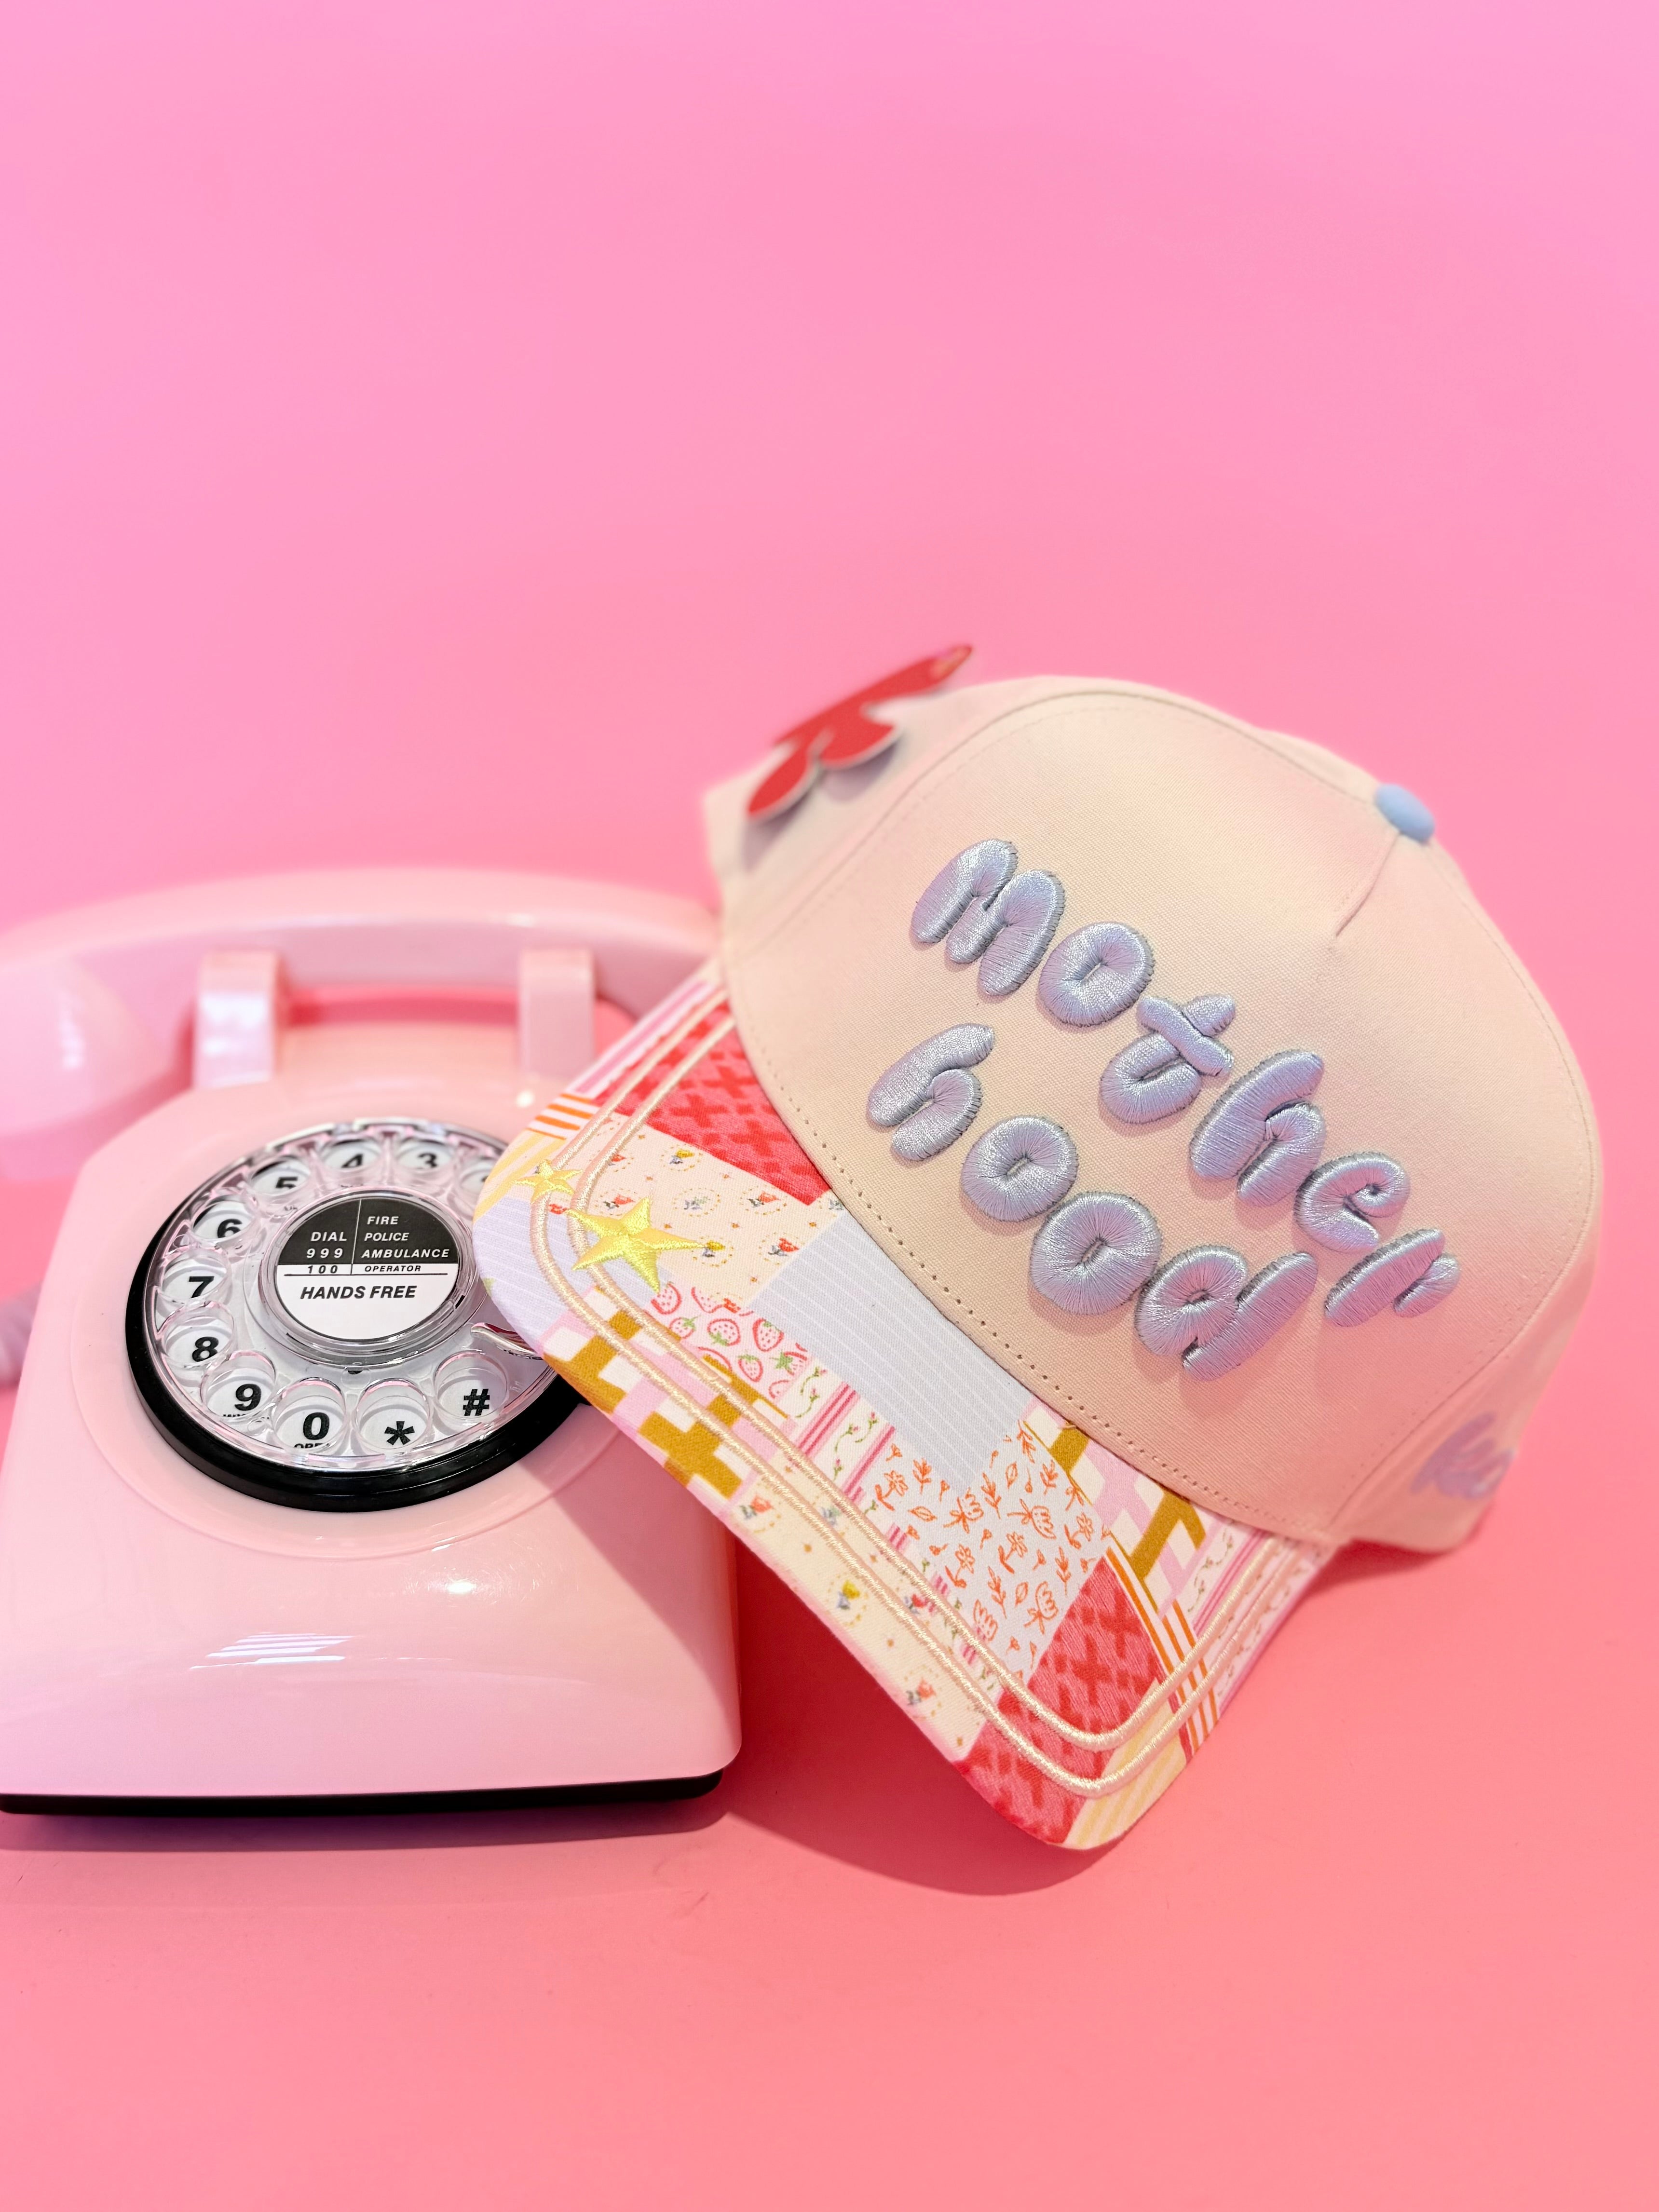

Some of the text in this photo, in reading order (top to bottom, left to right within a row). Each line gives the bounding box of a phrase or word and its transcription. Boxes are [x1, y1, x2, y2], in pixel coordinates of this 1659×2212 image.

[341, 1153, 364, 1168] 4
[419, 1153, 438, 1169] 3
[275, 1177, 298, 1189] 5
[867, 1023, 1318, 1381] hood
[367, 1216, 399, 1225] FIRE
[217, 1219, 243, 1239] 6
[311, 1232, 347, 1242] DIAL
[364, 1232, 409, 1242] POLICE
[361, 1248, 449, 1258] AMBULANCE
[189, 1276, 215, 1299] 7
[300, 1285, 418, 1300] HANDS FREE
[192, 1336, 219, 1362] 8
[234, 1383, 262, 1411] 9
[462, 1388, 490, 1416] #
[303, 1411, 330, 1440] 0
